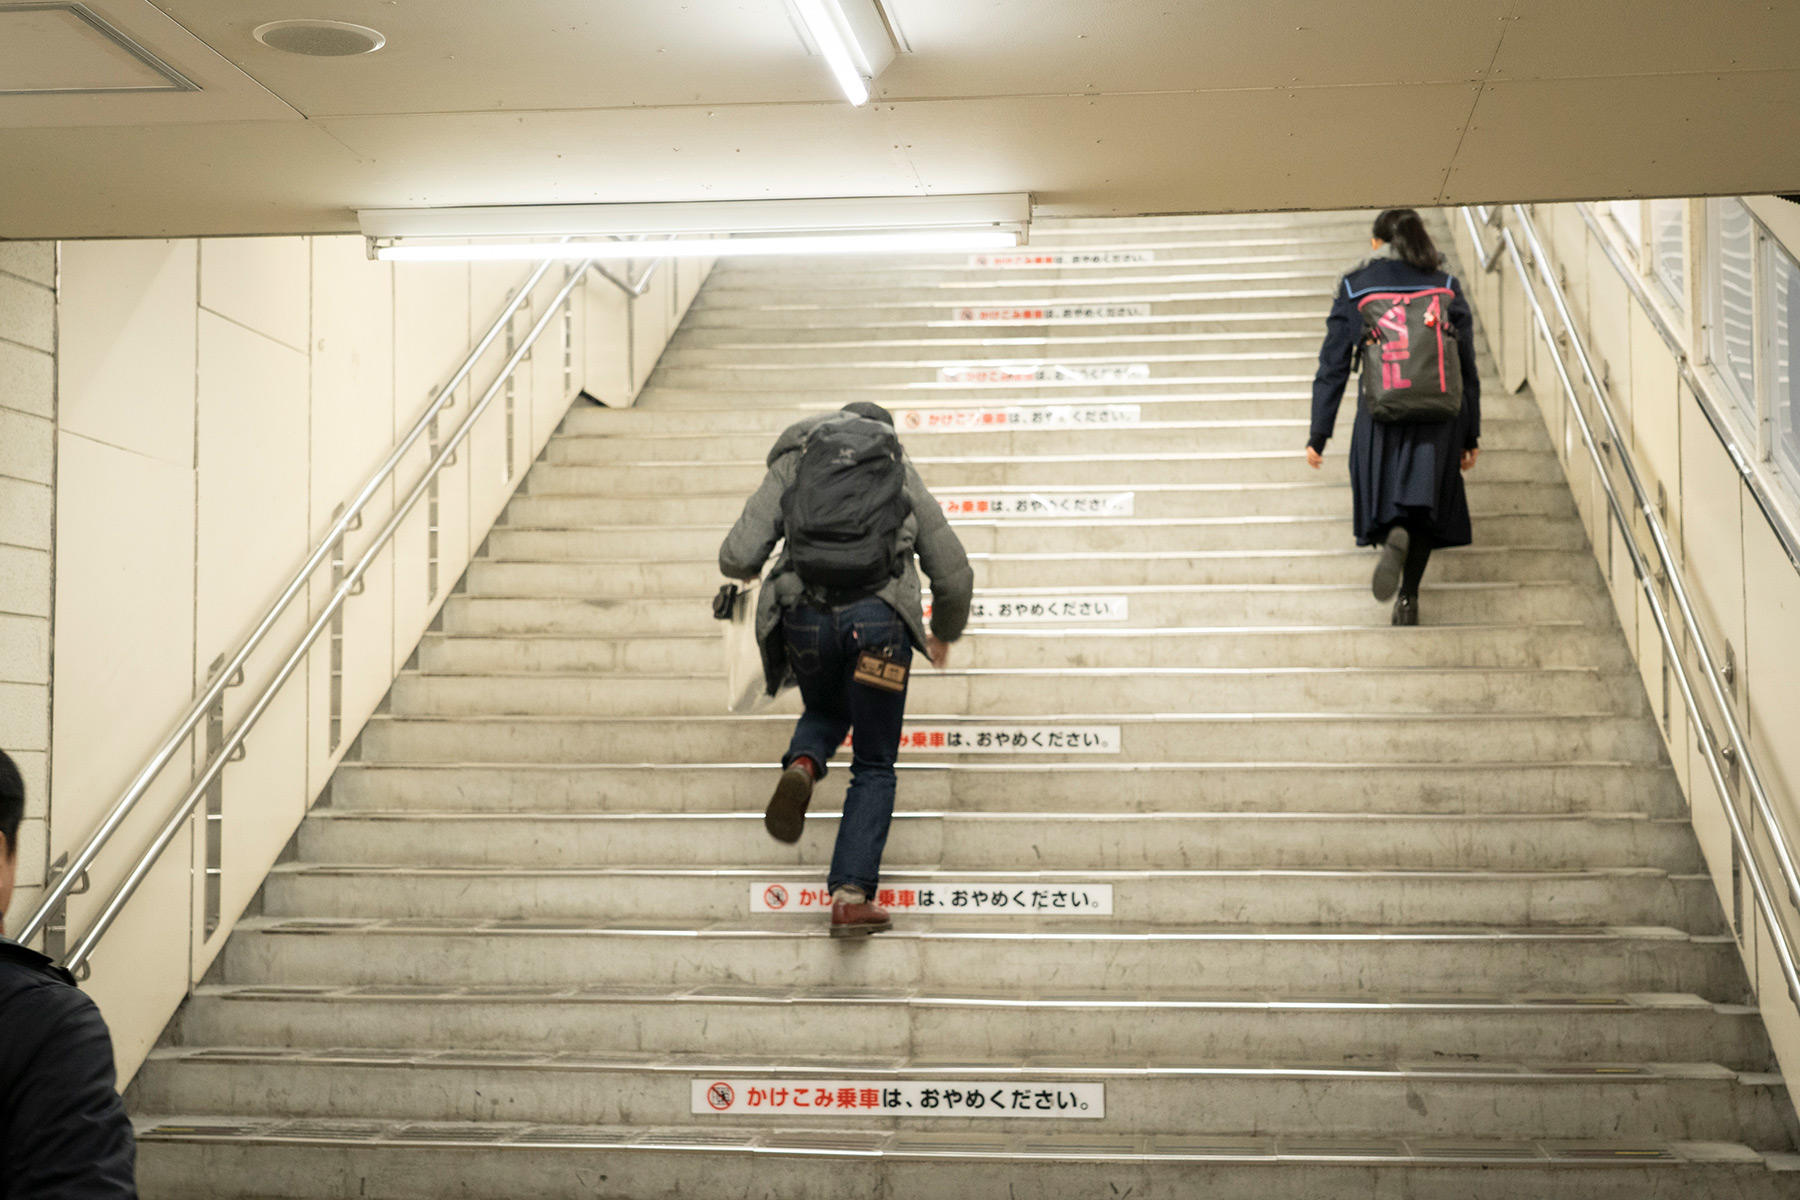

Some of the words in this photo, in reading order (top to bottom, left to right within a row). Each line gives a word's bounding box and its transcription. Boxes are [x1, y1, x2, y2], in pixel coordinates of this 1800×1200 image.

[1378, 305, 1412, 390] FILA
[799, 888, 1100, 908] かけ乗車は、おやめください。
[747, 1086, 1089, 1111] かけこみ乗車は、おやめください。
